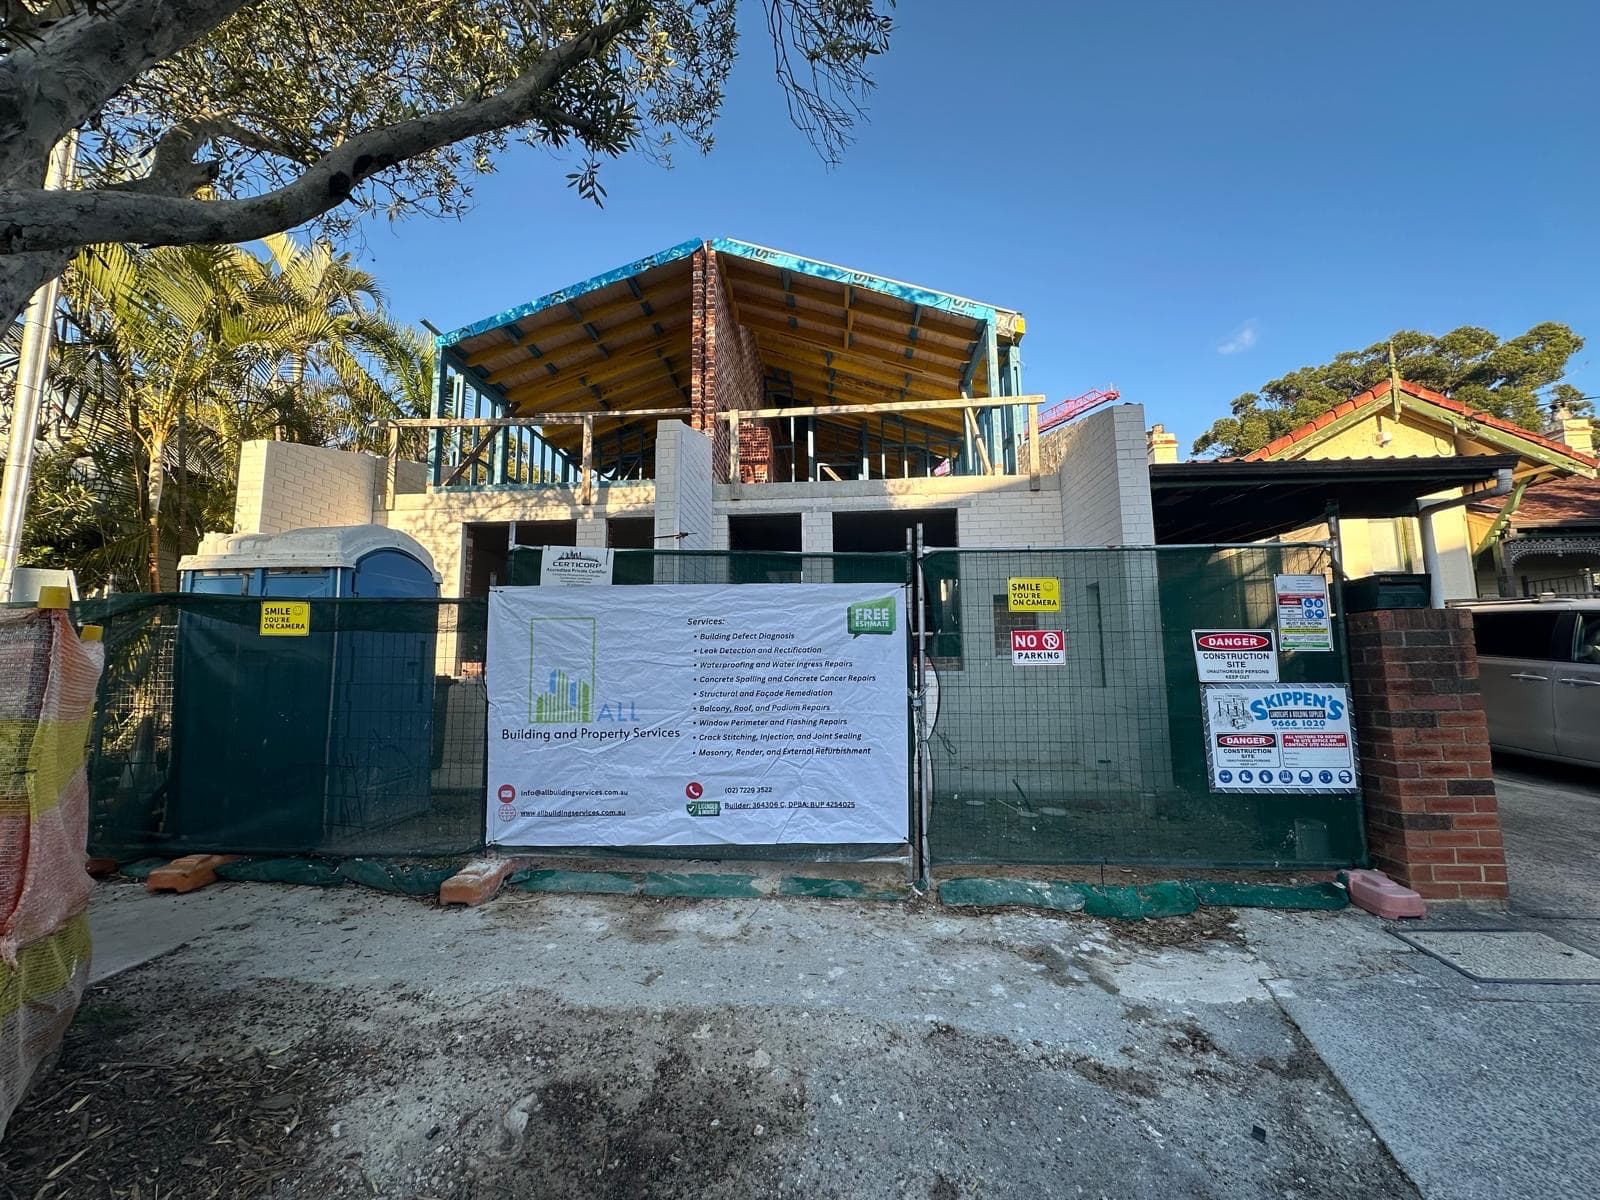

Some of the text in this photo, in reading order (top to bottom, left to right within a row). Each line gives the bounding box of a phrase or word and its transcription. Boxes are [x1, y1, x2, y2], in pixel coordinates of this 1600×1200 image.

[552, 561, 602, 569] CERTICORP
[1011, 583, 1040, 591] SMILE
[264, 607, 291, 615] SMILE
[855, 607, 889, 621] FREE
[687, 617, 725, 626] Services:
[855, 620, 889, 628] ESTIMATE
[700, 632, 795, 641] Building Defect Diagnosis
[1015, 635, 1037, 648] NO
[1208, 637, 1258, 646] DANGER
[700, 646, 822, 655] Leak Detection and Rectification
[1017, 651, 1060, 660] PARKING
[1202, 652, 1270, 660] CONSTRUCTION
[700, 661, 754, 670] Waterproofing
[796, 660, 823, 670] Ingress
[824, 660, 853, 670] Repairs
[735, 675, 766, 685] Spalling
[767, 675, 783, 683] and
[819, 674, 847, 682] Cancer
[847, 674, 876, 684] Repairs
[699, 689, 833, 699] Structural and Façade Remediation
[699, 704, 732, 714] Balcony,
[733, 704, 753, 713] Roof,
[755, 704, 770, 712] and
[801, 704, 830, 713] Repairs
[1250, 691, 1345, 720] SKIPPEN'S
[596, 702, 640, 722] ALL
[769, 718, 784, 726] and
[786, 718, 817, 727] Flashing
[818, 718, 848, 727] Repairs
[501, 727, 680, 742] Building and Property Services
[699, 732, 862, 742] Crack Stitching, Injection, and Joint Sealing
[698, 747, 871, 758] Masonry, Render, and External Refurbishment
[724, 786, 773, 794] (02) 7229 3522
